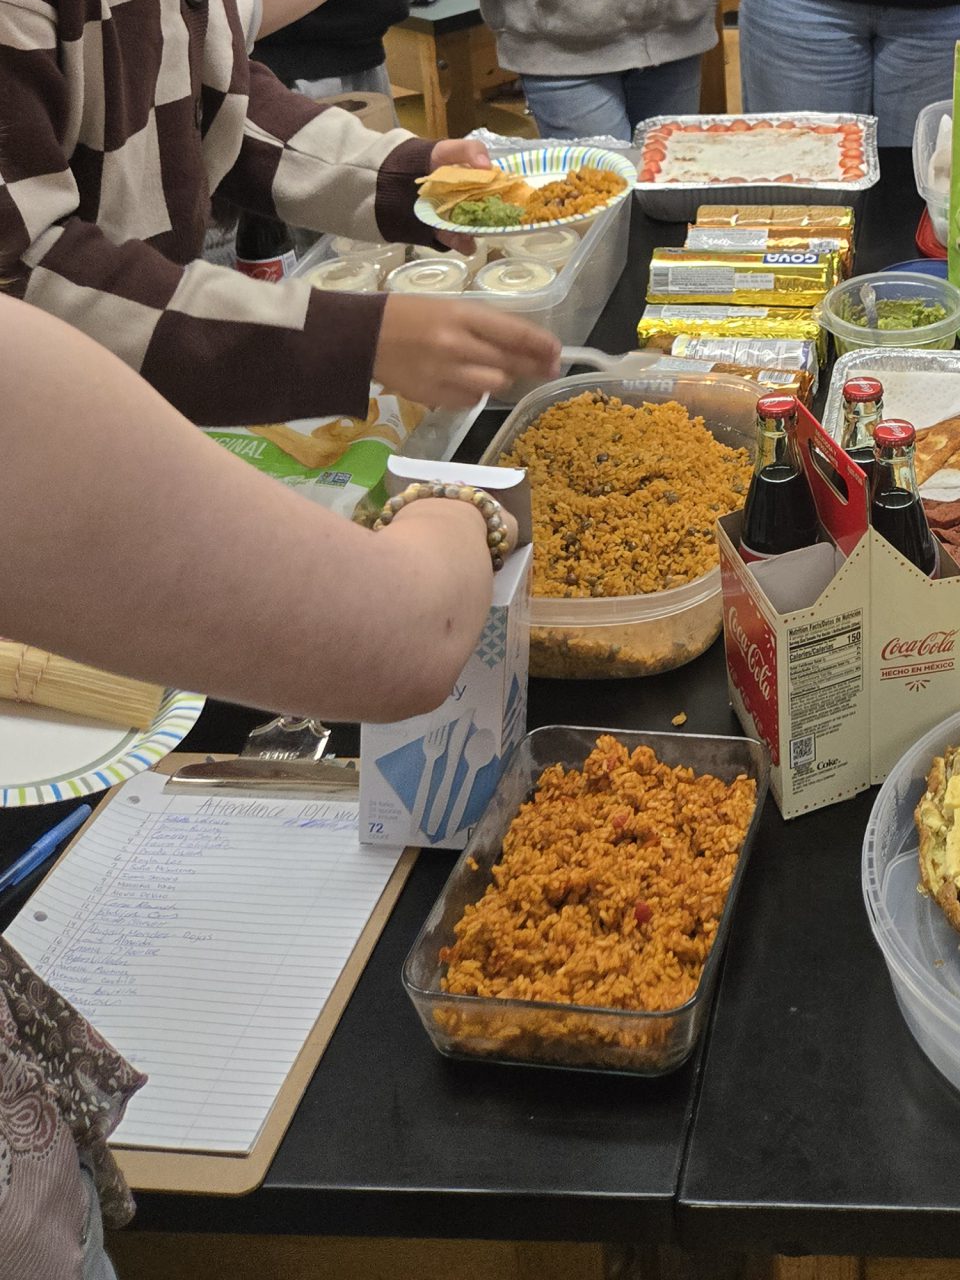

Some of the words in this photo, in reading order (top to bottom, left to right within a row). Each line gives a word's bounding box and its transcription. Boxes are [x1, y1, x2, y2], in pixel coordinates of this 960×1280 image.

[767, 253, 817, 263] GOYA
[215, 437, 267, 459] GINAL
[847, 631, 860, 643] 150
[881, 628, 960, 661] Coca-Cola
[881, 668, 909, 677] HECHO
[924, 661, 954, 671] MÉXICO
[368, 822, 384, 834] 72
